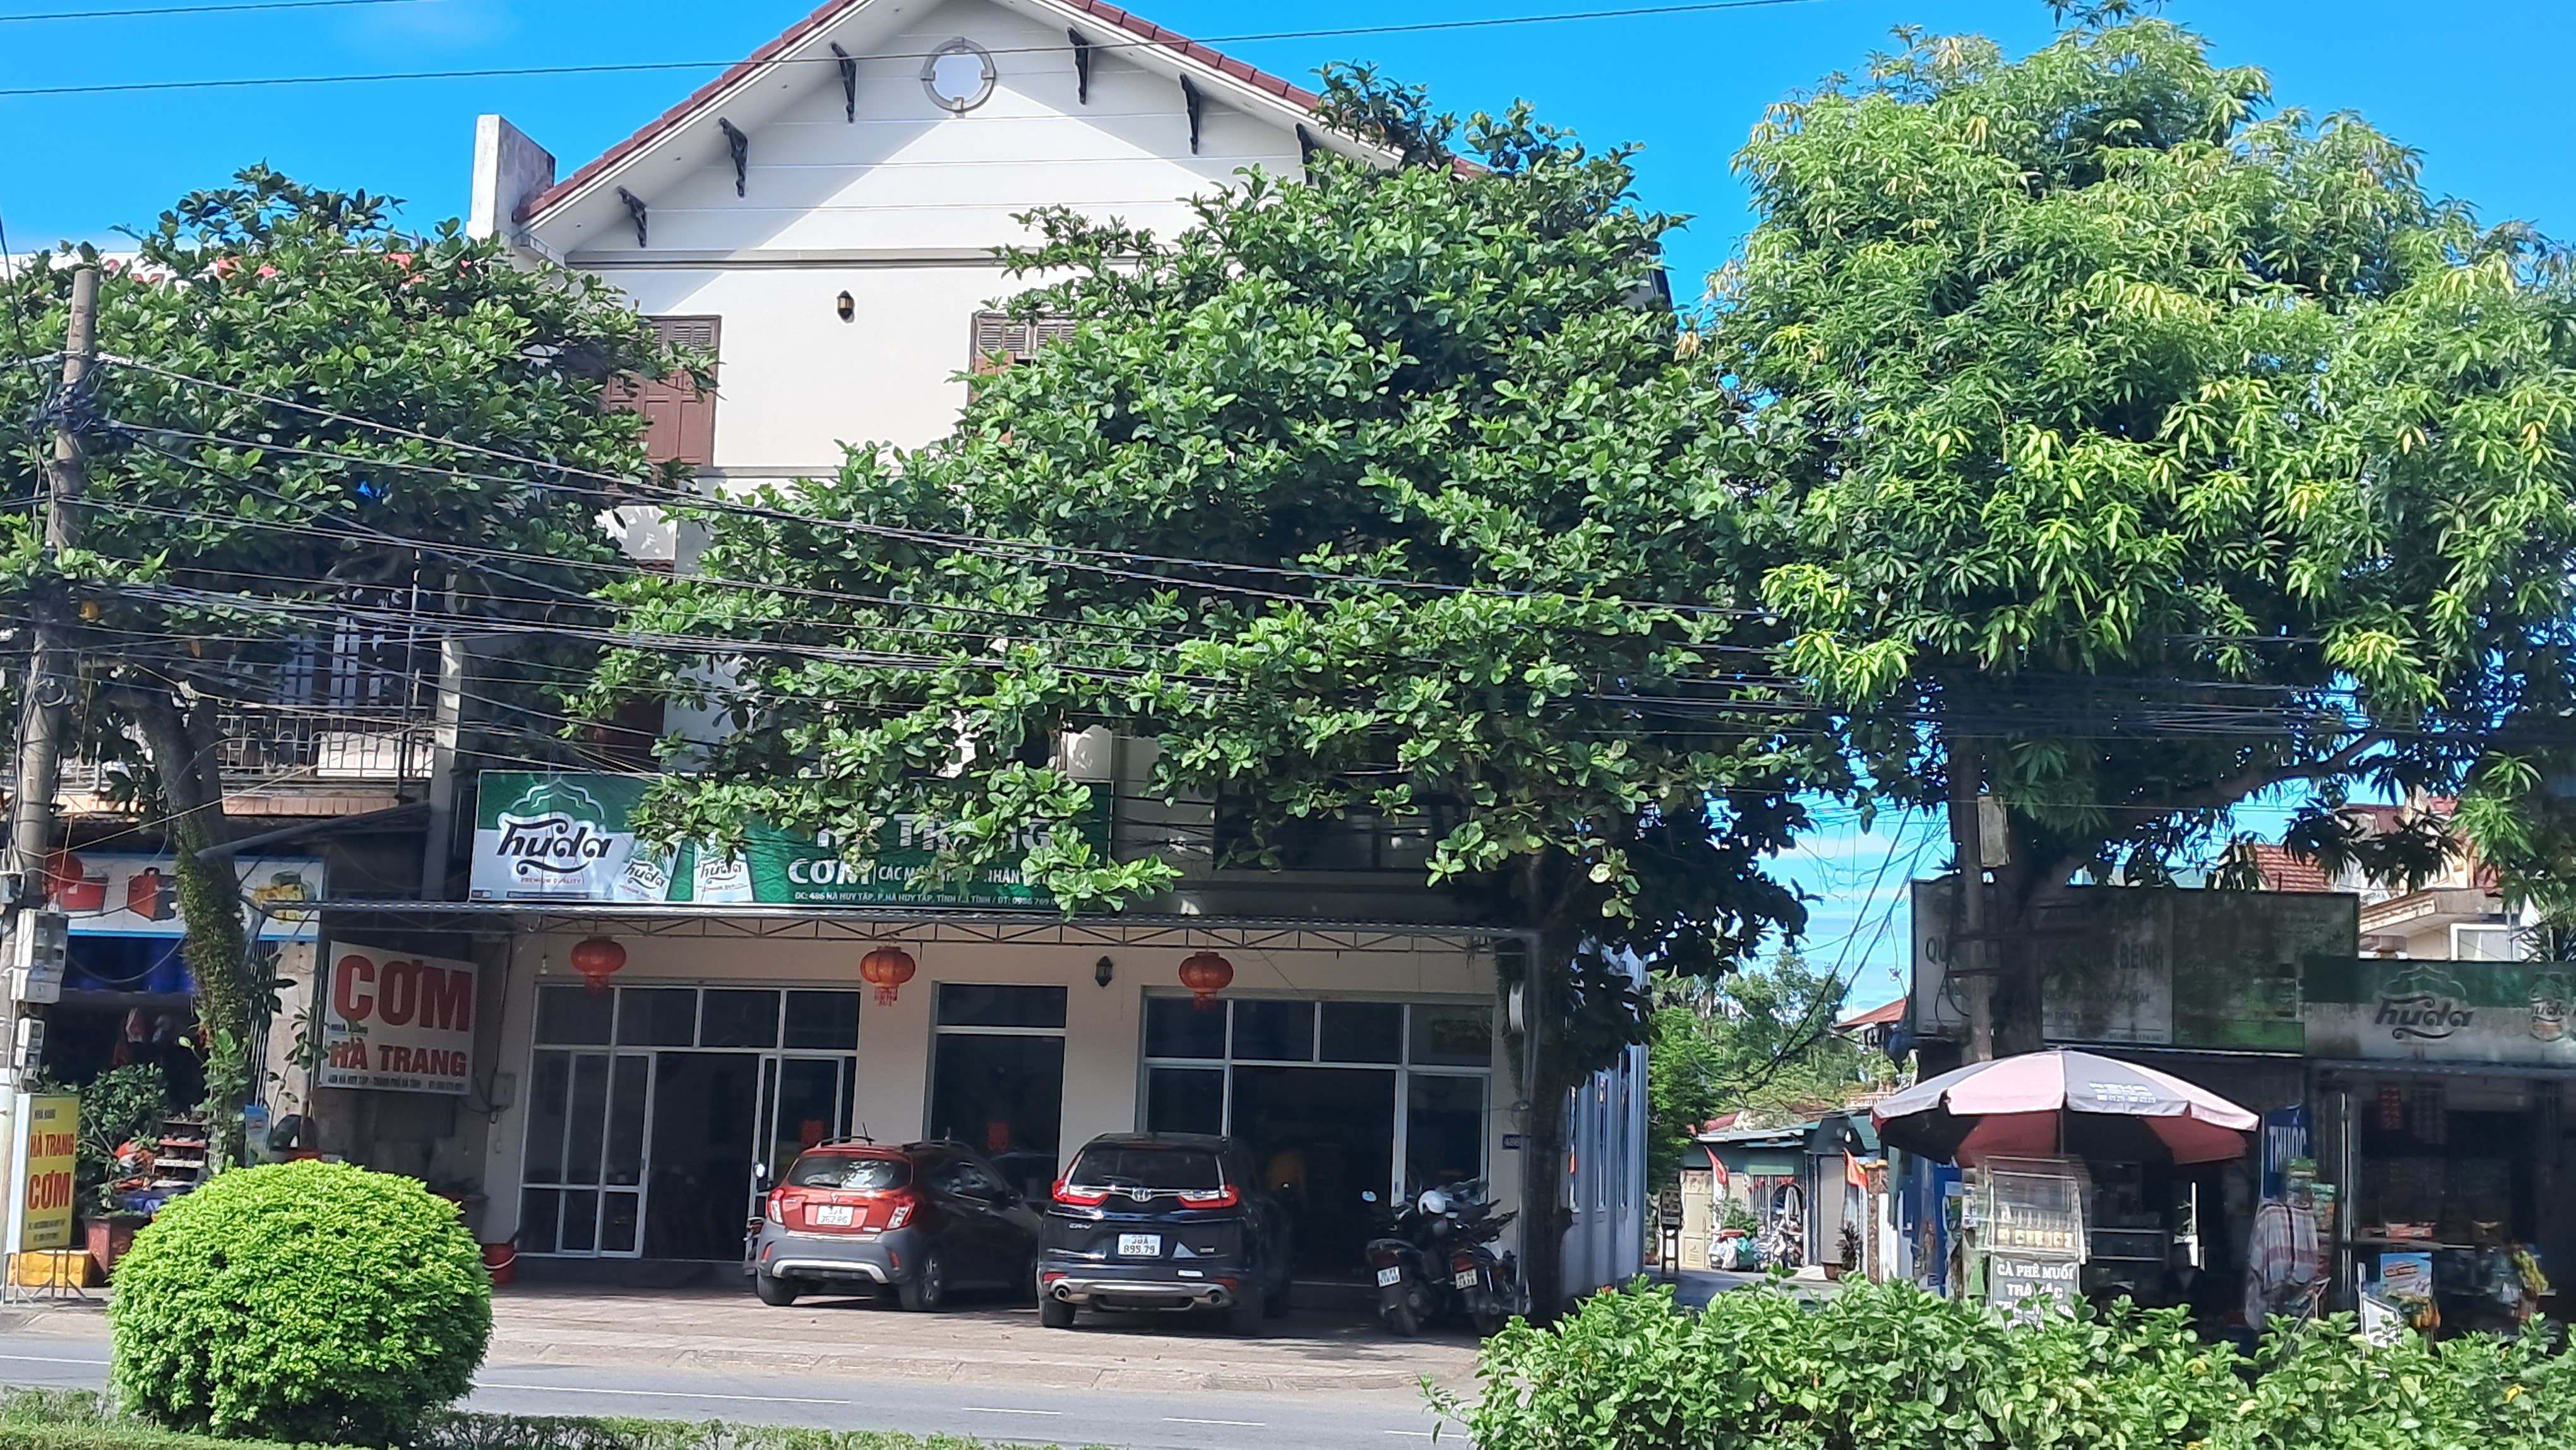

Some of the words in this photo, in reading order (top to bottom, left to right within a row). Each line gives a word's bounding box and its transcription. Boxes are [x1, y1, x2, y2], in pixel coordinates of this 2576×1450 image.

[496, 818, 614, 858] huda
[623, 860, 665, 887] huda
[878, 863, 903, 880] CÁC
[333, 955, 473, 1032] CƠM
[2374, 996, 2474, 1028] huda
[329, 1037, 368, 1070] HÀ
[378, 1045, 467, 1077] TRANG
[30, 1130, 42, 1158] HÀ
[45, 1133, 74, 1157] TRANG
[27, 1170, 71, 1209] CƠM
[1997, 1261, 2013, 1276] CÀ
[2016, 1262, 2040, 1278] PHÊ
